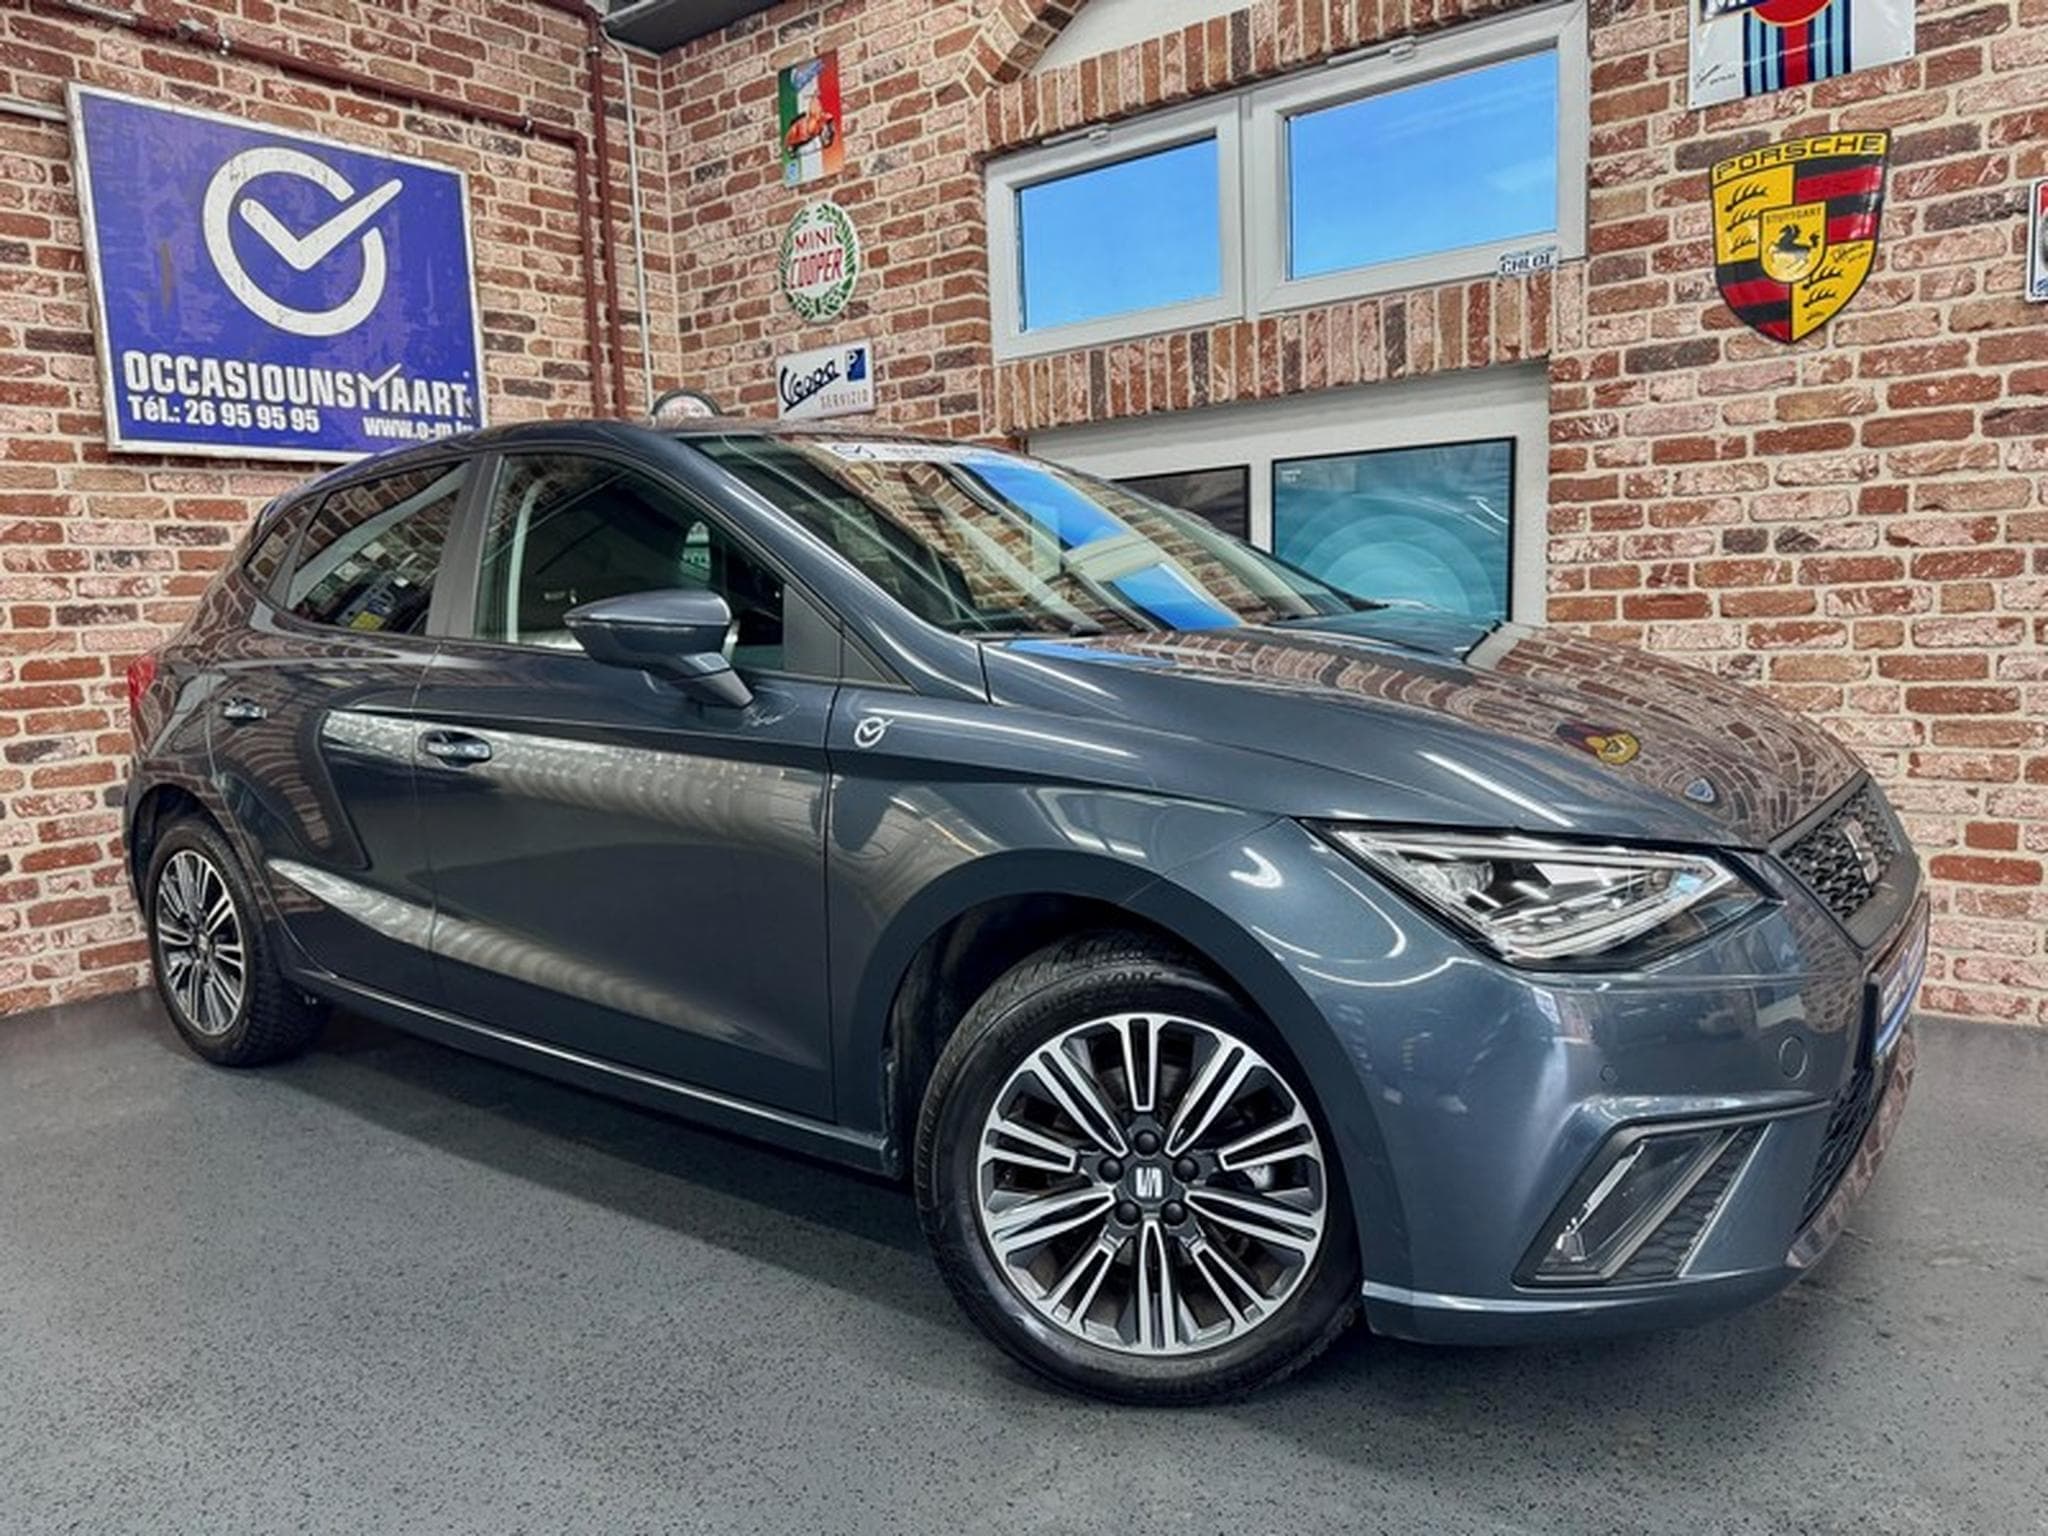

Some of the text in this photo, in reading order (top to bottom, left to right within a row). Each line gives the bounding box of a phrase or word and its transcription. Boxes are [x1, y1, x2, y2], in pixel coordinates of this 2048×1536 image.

[1716, 134, 1884, 181] PORSCHE
[795, 225, 834, 252] MINI
[788, 247, 843, 289] COOPER
[123, 350, 468, 418] OCCASIOUNSMAART
[784, 360, 841, 413] Vespa
[127, 395, 321, 433] Tél.: 26 95 95 95
[362, 416, 474, 440] www.o-ml
